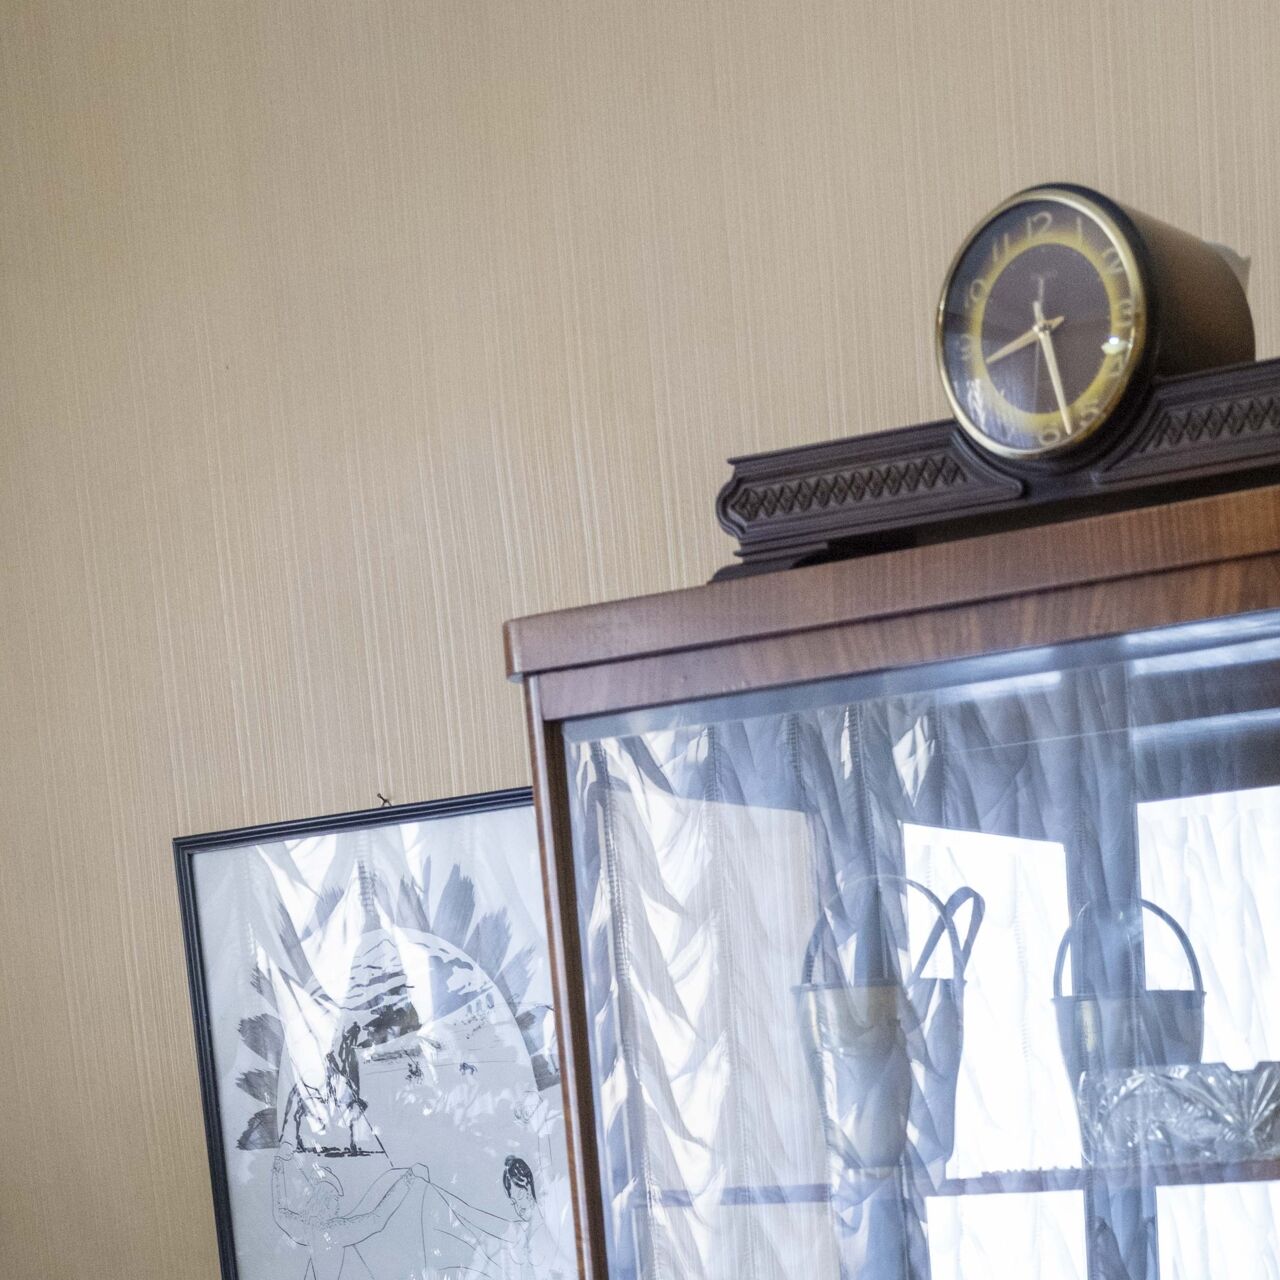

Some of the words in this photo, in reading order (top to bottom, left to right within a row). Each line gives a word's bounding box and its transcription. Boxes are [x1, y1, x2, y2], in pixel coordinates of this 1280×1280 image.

[1026, 211, 1053, 238] 12
[1076, 216, 1083, 244] 1
[992, 234, 1009, 262] 11
